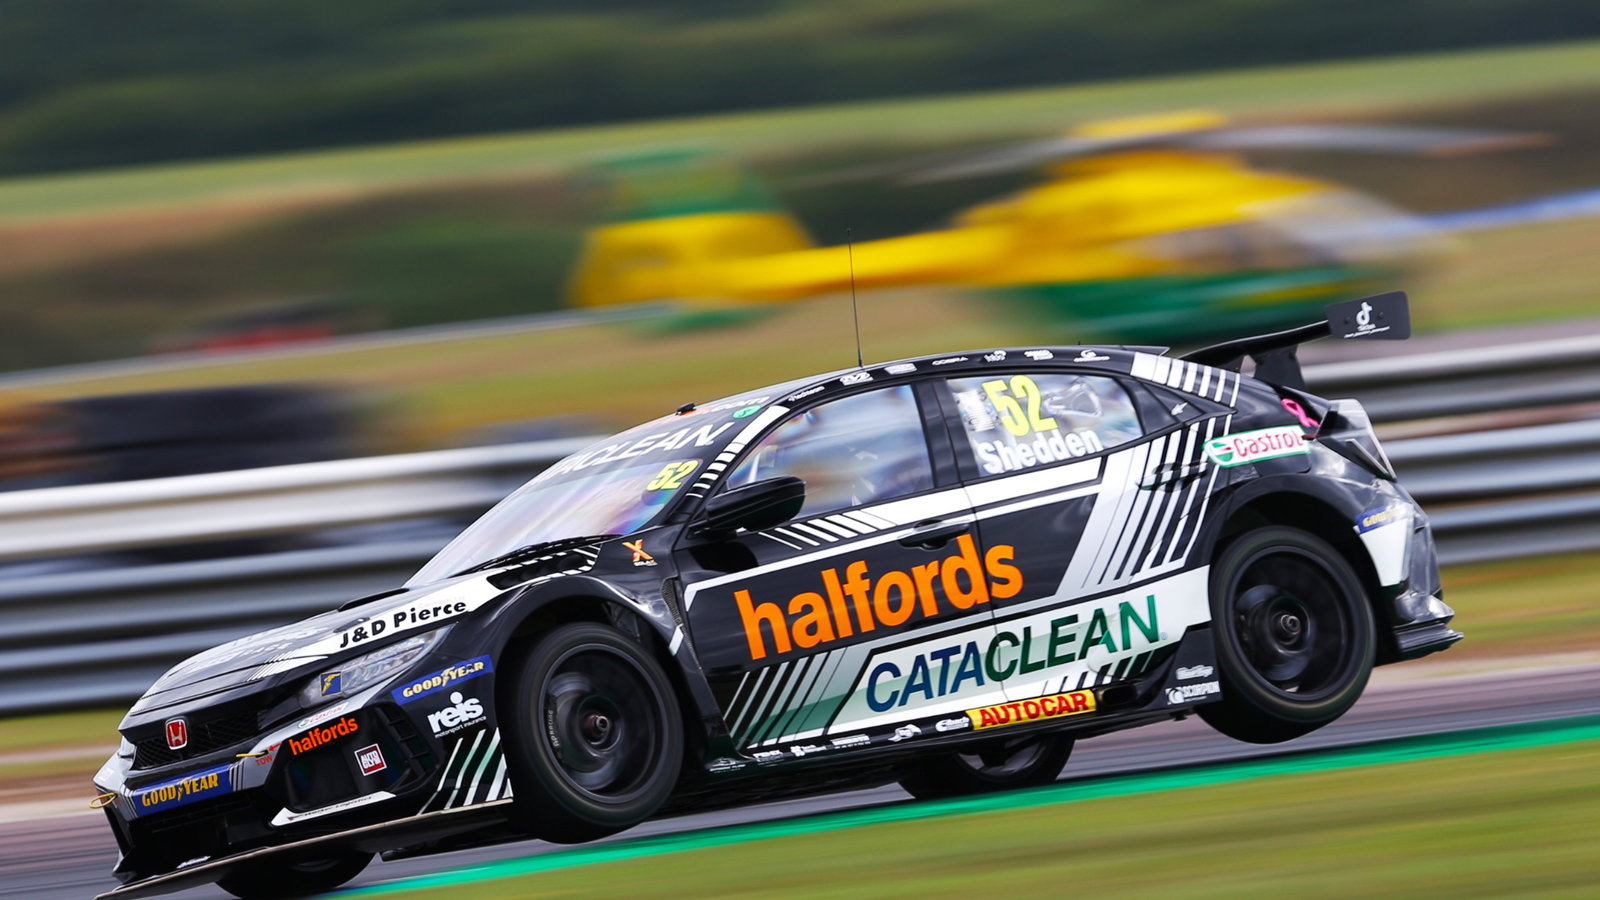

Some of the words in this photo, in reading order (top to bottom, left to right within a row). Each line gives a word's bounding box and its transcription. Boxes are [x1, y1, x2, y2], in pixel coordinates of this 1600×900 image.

[981, 375, 1058, 436] 52
[977, 428, 1104, 474] Shedden
[1233, 430, 1304, 458] Castrol
[646, 460, 699, 491] 52
[734, 534, 1023, 660] halfords
[340, 619, 386, 648] J&D
[393, 602, 467, 628] Pierce
[866, 595, 1161, 712] CATACLEAN
[427, 691, 484, 733] reis
[981, 692, 1089, 727] AUTOCAR
[288, 717, 359, 756] halfords
[255, 755, 273, 766] TOW
[142, 773, 219, 807] GOODYEAR
